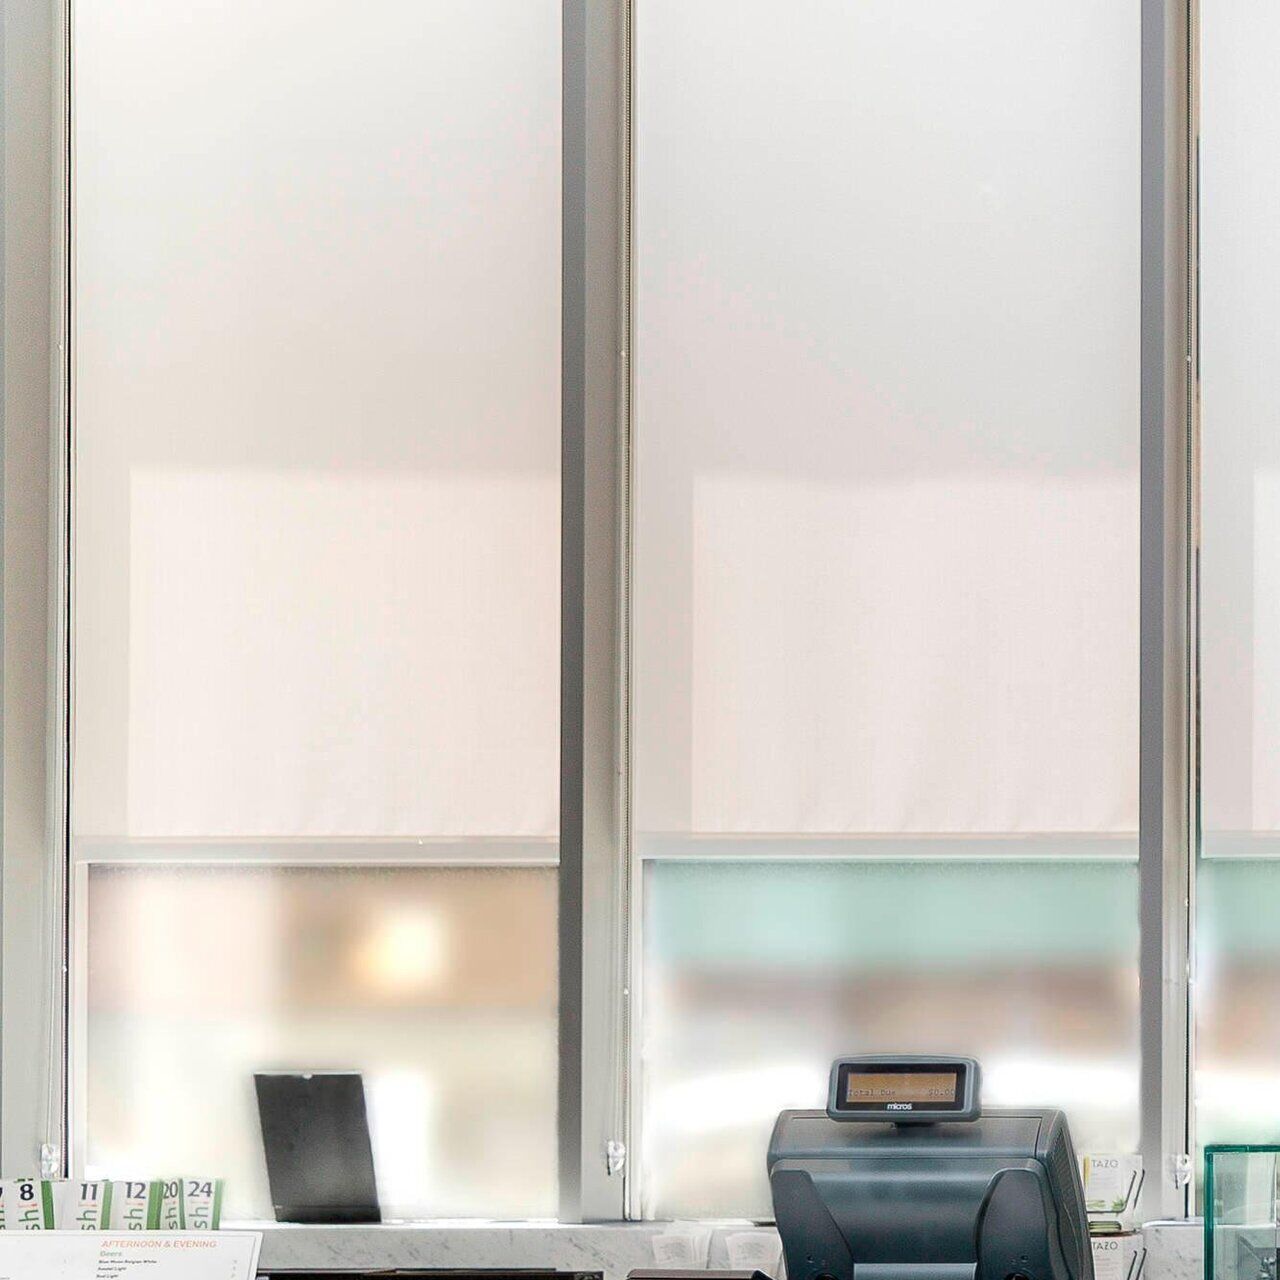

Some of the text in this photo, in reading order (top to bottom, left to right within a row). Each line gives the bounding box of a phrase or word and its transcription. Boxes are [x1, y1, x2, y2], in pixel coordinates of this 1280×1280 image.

[886, 1102, 913, 1110] micros
[1092, 1159, 1119, 1168] TAZO
[19, 1183, 35, 1201] 8
[80, 1183, 98, 1200] 11
[125, 1182, 147, 1199] 12
[187, 1180, 213, 1198] 24
[101, 1240, 217, 1249] AFTERNOON & EVENING
[1092, 1241, 1119, 1250] TAZO
